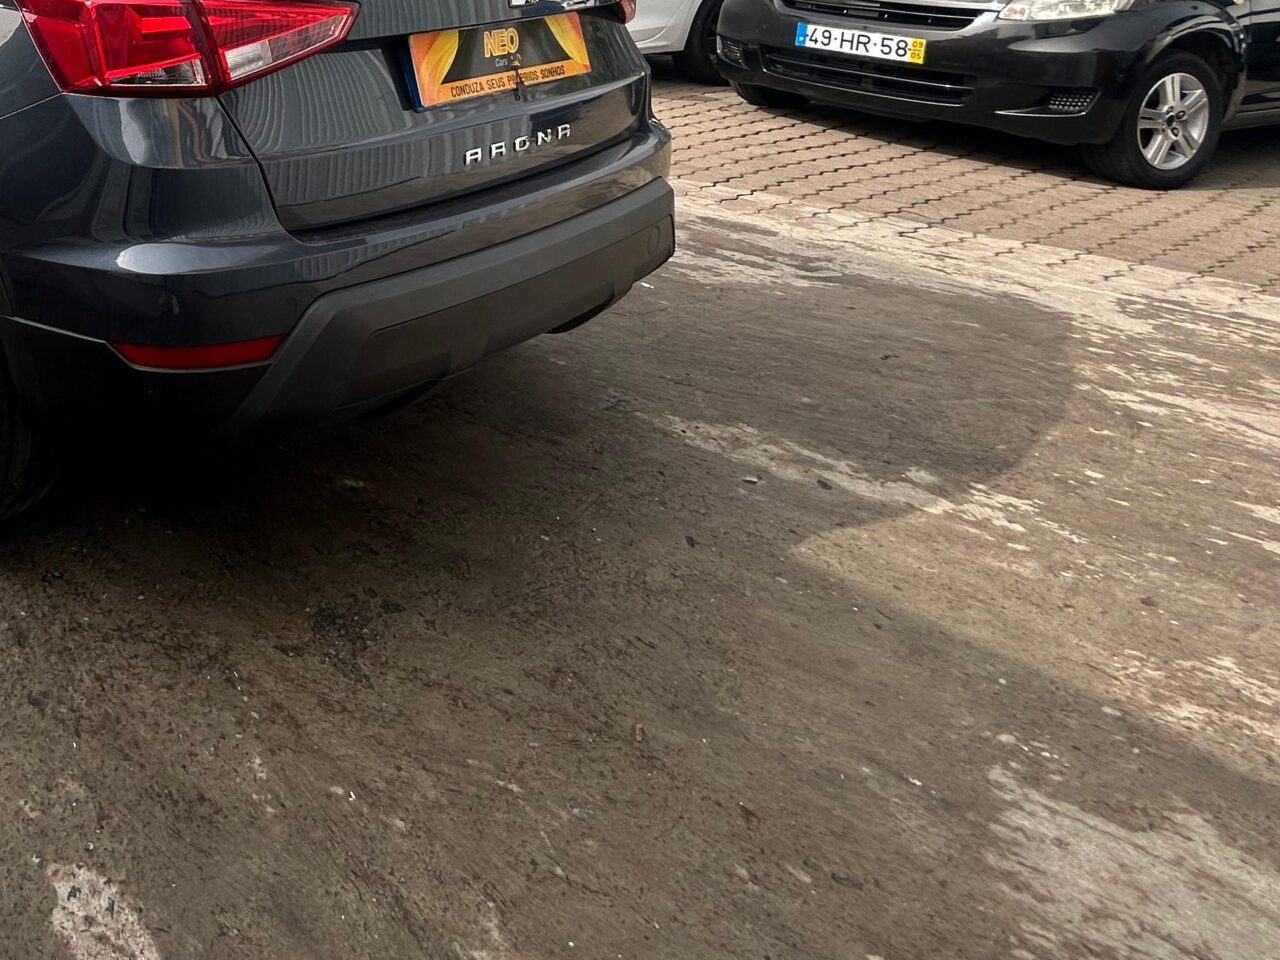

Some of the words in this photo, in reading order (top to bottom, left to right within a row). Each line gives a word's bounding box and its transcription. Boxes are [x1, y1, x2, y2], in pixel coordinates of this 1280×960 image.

[483, 27, 519, 58] NEO
[912, 40, 924, 49] 09
[495, 57, 508, 67] Cars
[910, 51, 922, 60] 05
[450, 82, 485, 98] CONDUZA
[486, 78, 506, 90] SEUS
[540, 64, 566, 80] SONHOS
[464, 123, 571, 166] ARONA
